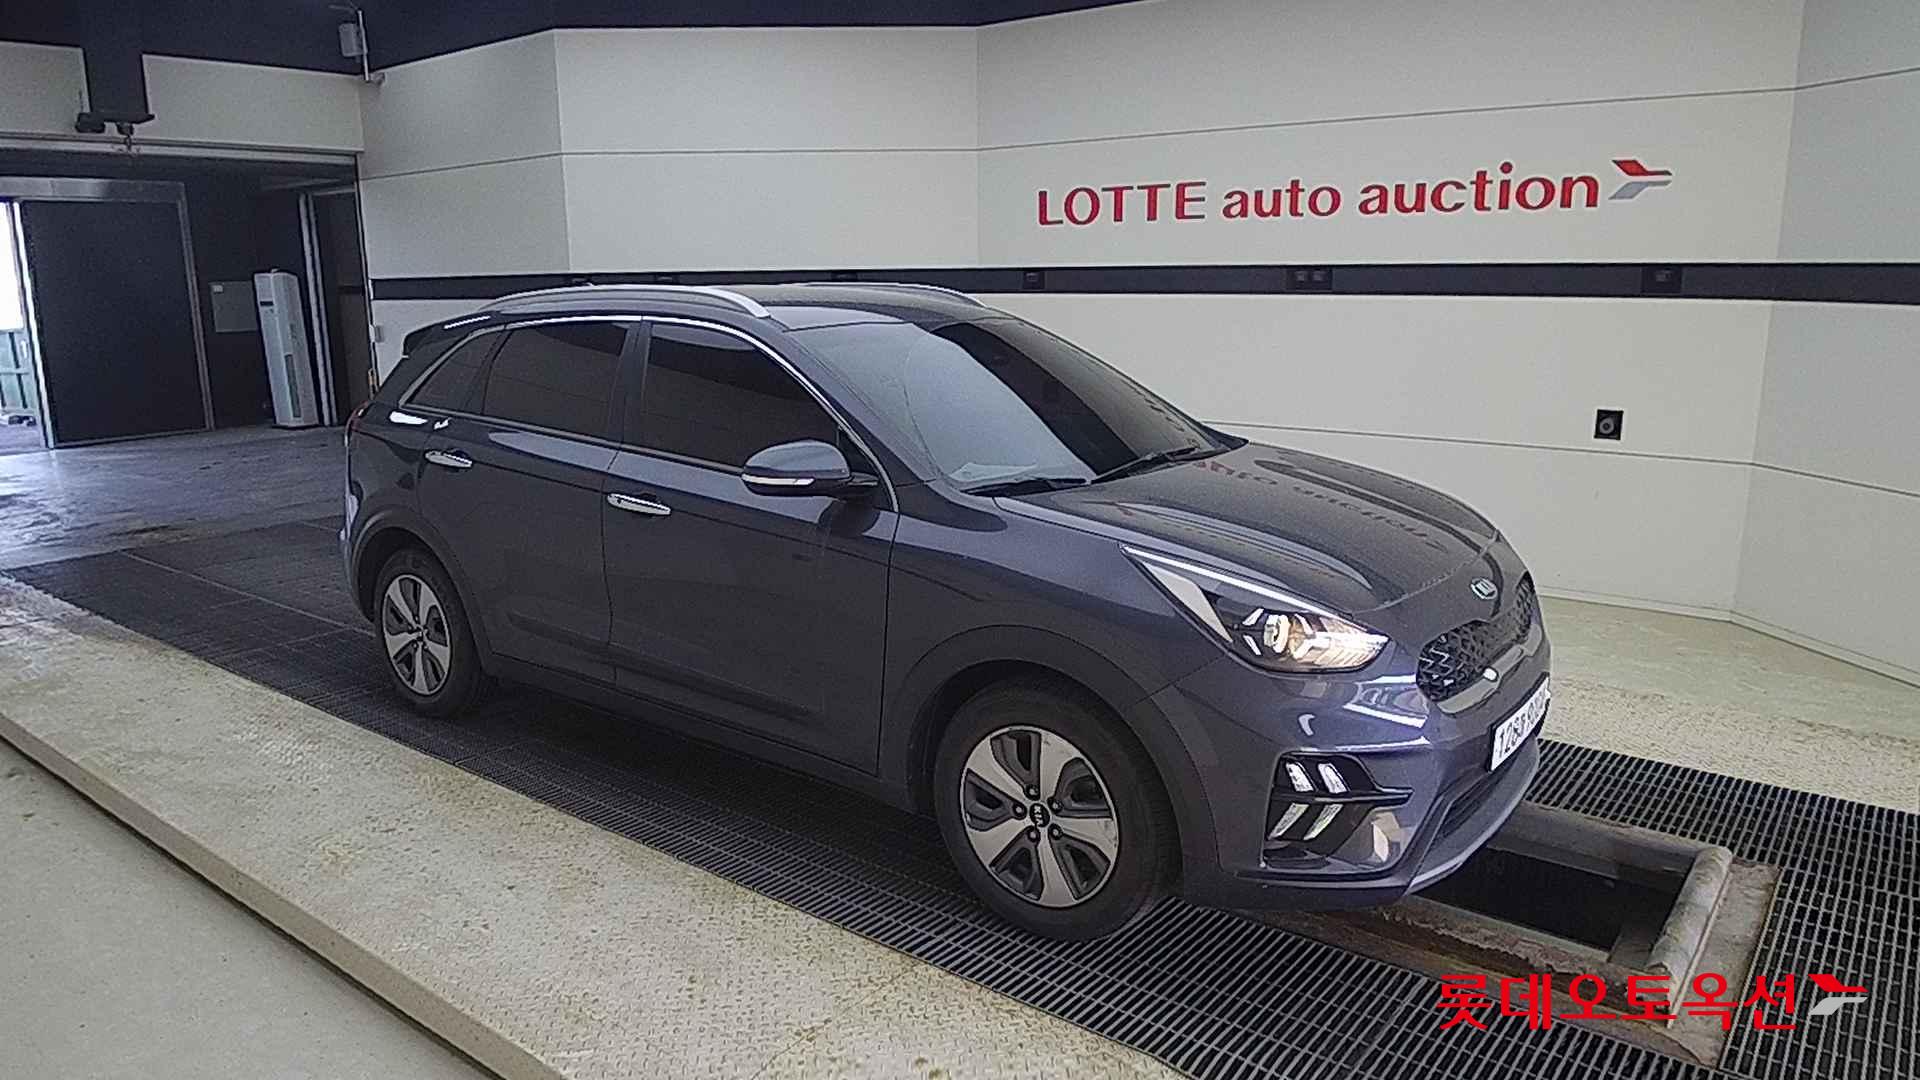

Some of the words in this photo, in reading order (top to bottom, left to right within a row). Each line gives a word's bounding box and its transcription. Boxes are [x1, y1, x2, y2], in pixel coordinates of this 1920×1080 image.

[1038, 181, 1206, 225] LOTTE
[1223, 178, 1342, 219] auto
[1358, 161, 1600, 215] auction
